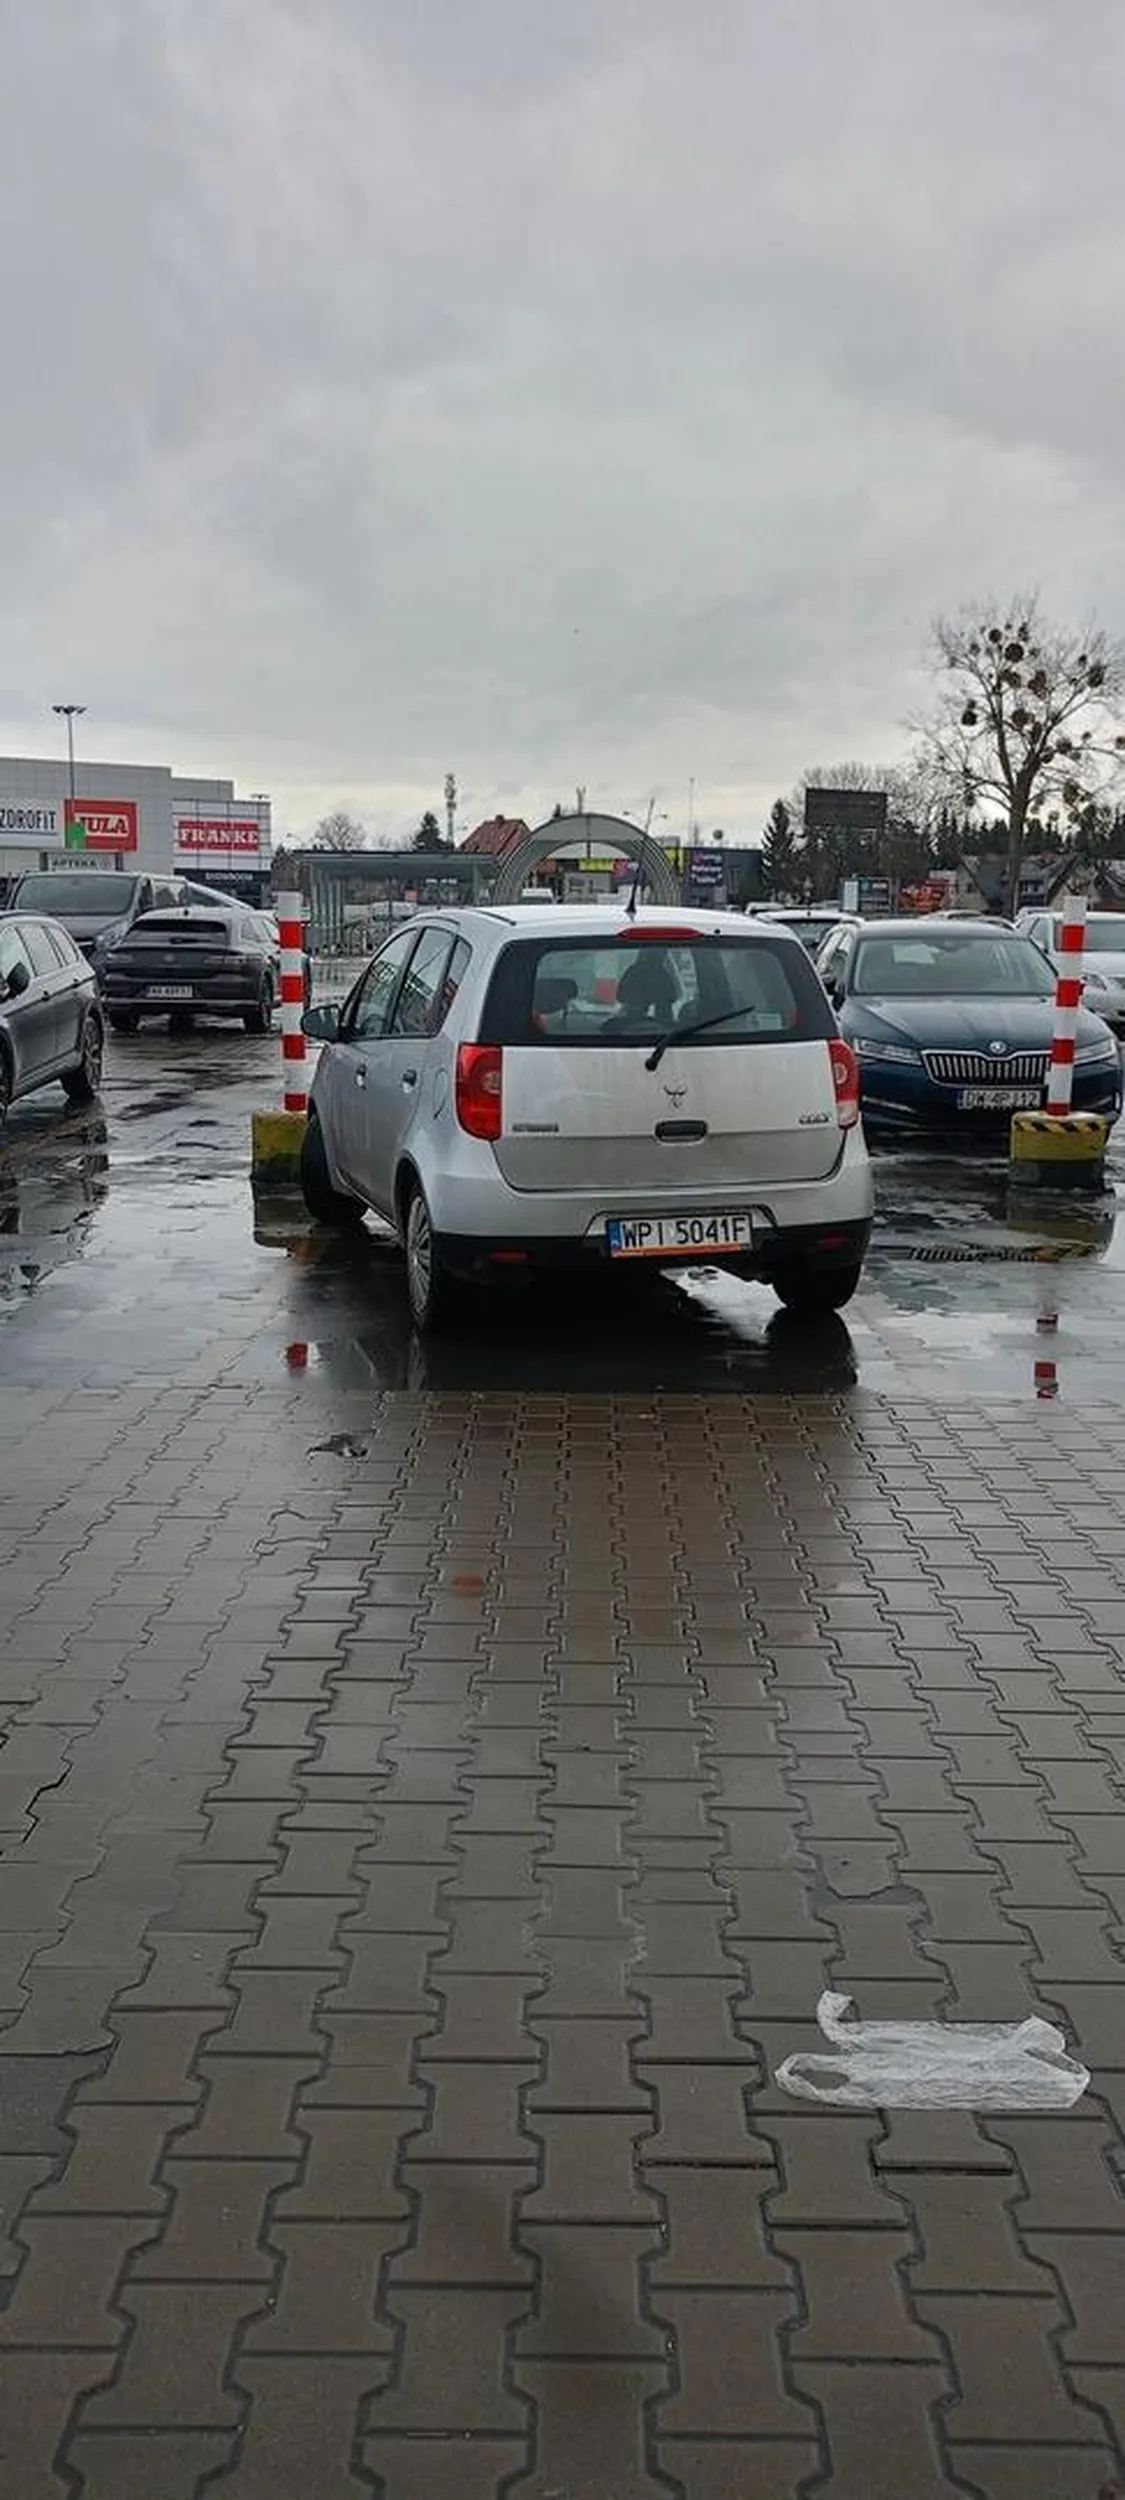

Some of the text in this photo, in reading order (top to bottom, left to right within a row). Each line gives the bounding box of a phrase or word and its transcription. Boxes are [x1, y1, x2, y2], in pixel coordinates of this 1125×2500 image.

[181, 829, 259, 844] FRANKE
[622, 1217, 746, 1248] WPI 5041F
